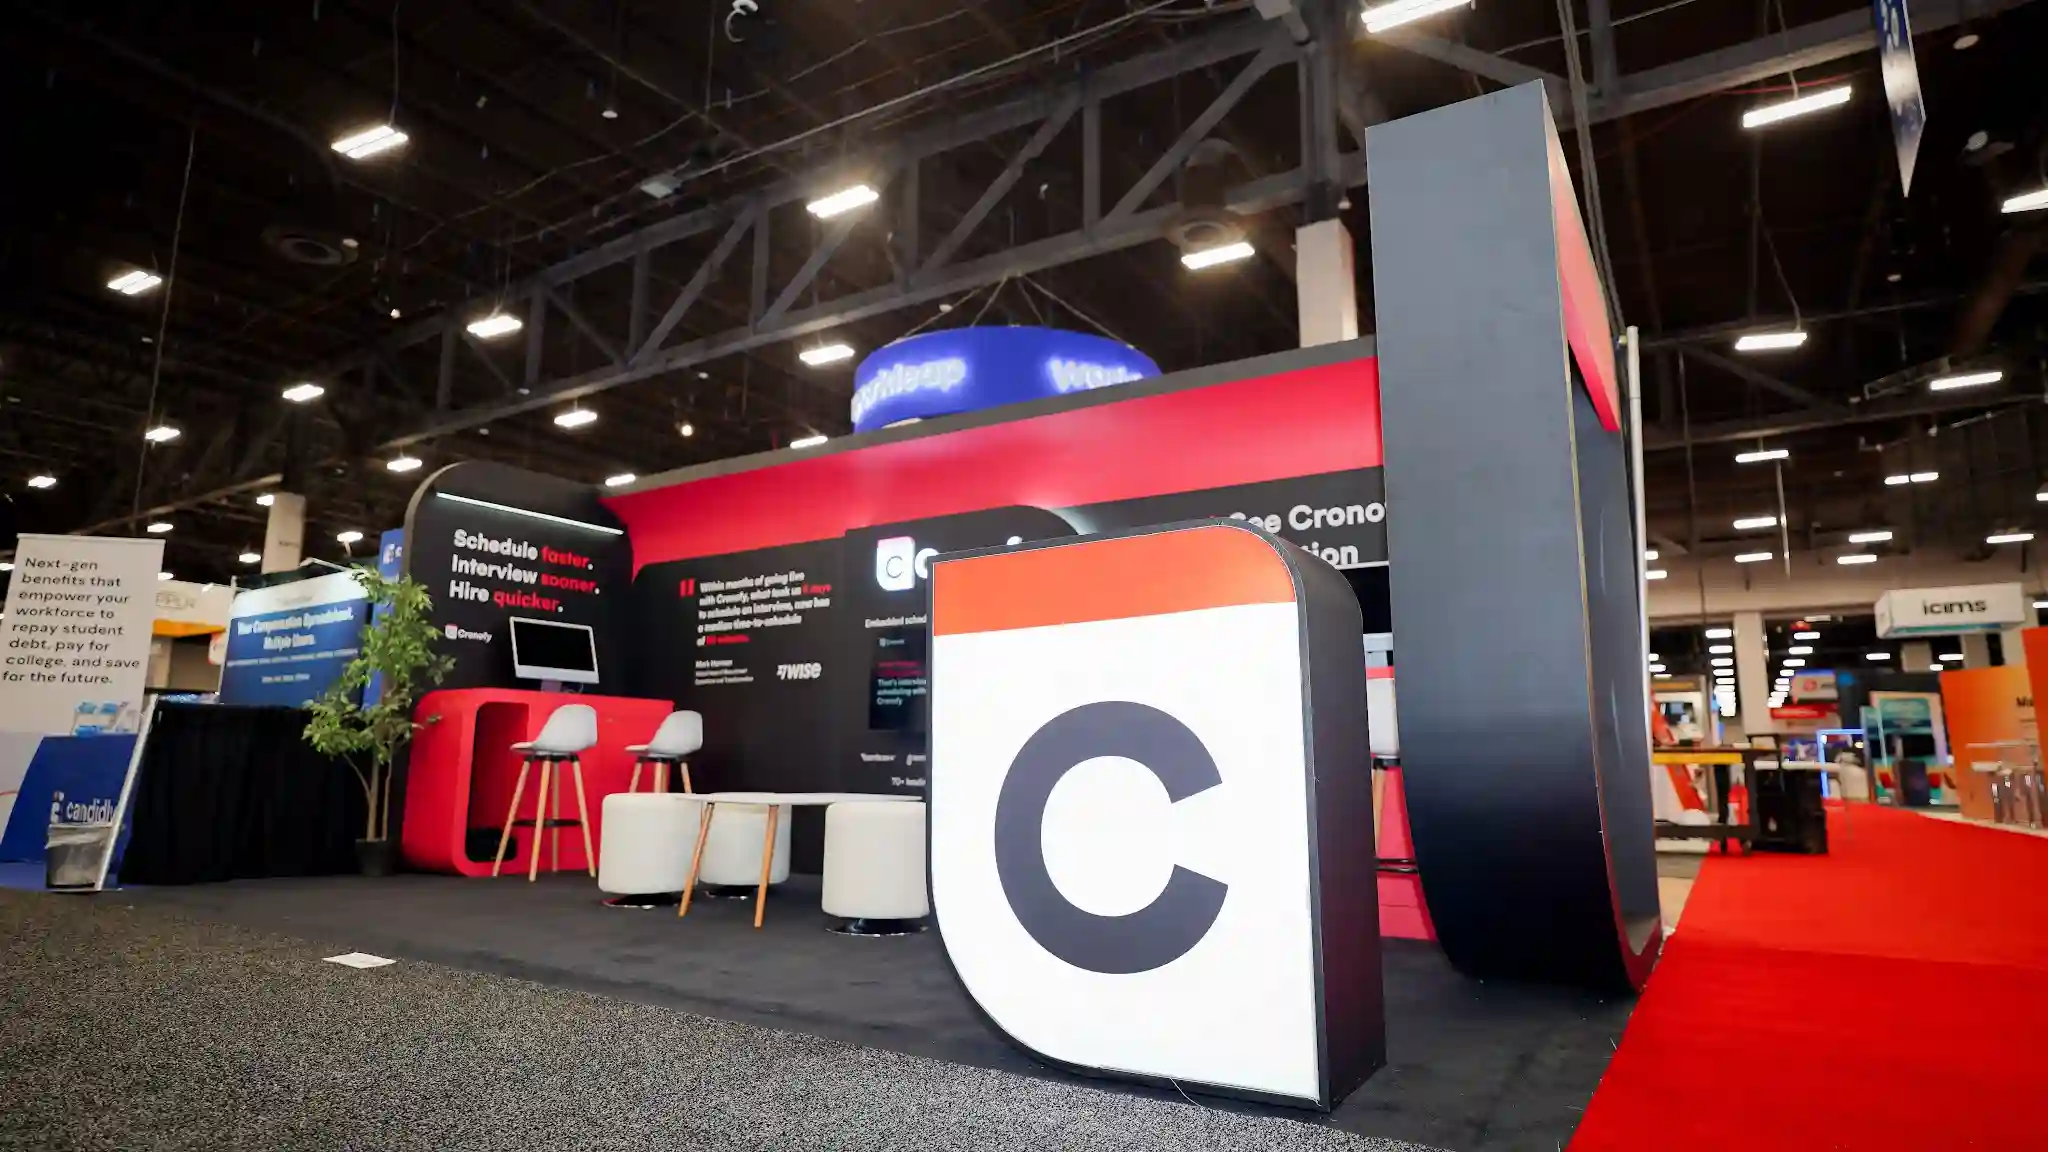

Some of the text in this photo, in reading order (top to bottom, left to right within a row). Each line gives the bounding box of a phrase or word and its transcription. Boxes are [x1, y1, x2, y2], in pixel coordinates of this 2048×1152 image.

[850, 358, 967, 424] orkleap
[1288, 502, 1387, 530] Crono
[453, 528, 594, 571] Schedule faster.
[1300, 541, 1359, 566] ion
[25, 557, 98, 572] Next-gen
[22, 573, 121, 587] benefits that
[451, 554, 600, 595] Interview sooner.
[19, 591, 131, 605] empower your
[449, 579, 564, 614] Hire quicker.
[16, 606, 115, 620] workforce to
[12, 623, 125, 636] repay student
[55, 640, 84, 652] pay
[89, 640, 111, 651] for
[72, 657, 101, 668] and
[105, 659, 140, 669] save
[3, 670, 113, 684] for the future.
[995, 701, 1229, 974] C
